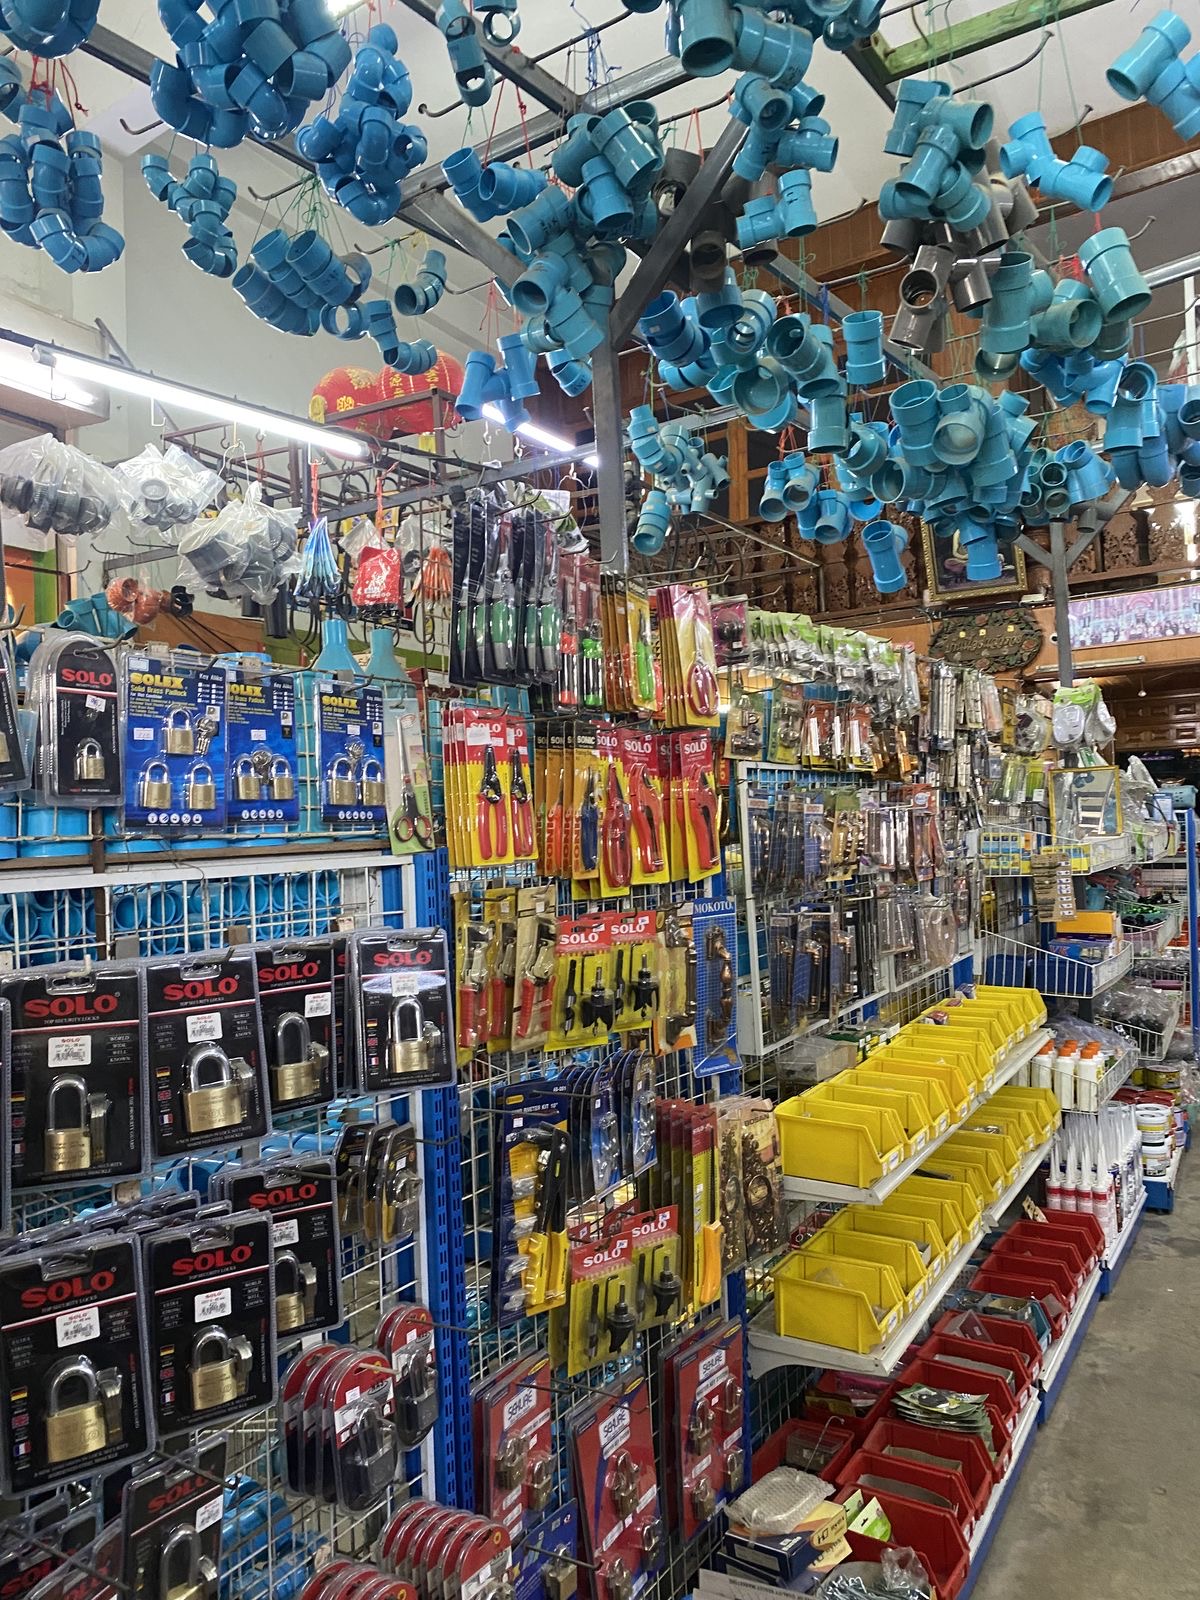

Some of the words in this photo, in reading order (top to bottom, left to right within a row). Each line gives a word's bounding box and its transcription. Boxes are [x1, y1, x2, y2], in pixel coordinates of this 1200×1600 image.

[61, 668, 113, 687] SOLO
[129, 672, 185, 690] SOLEX
[322, 695, 358, 708] SOLEX
[577, 736, 596, 744] SONIC
[596, 736, 618, 747] SOLO
[624, 740, 651, 754] SOLO
[684, 742, 707, 754] SOLO
[694, 901, 732, 914] MOKOTO
[560, 932, 598, 944] SOLO
[611, 924, 645, 934] SOLO
[374, 950, 432, 968] SOLO
[258, 962, 318, 983] SOLO
[162, 977, 238, 1001] SOLO
[24, 994, 118, 1018] SOLO
[249, 1183, 317, 1208] SOLO
[632, 1220, 667, 1238] SOLO
[172, 1245, 252, 1276] SOLO
[584, 1248, 621, 1267] SOLO
[21, 1270, 114, 1309] SOLO
